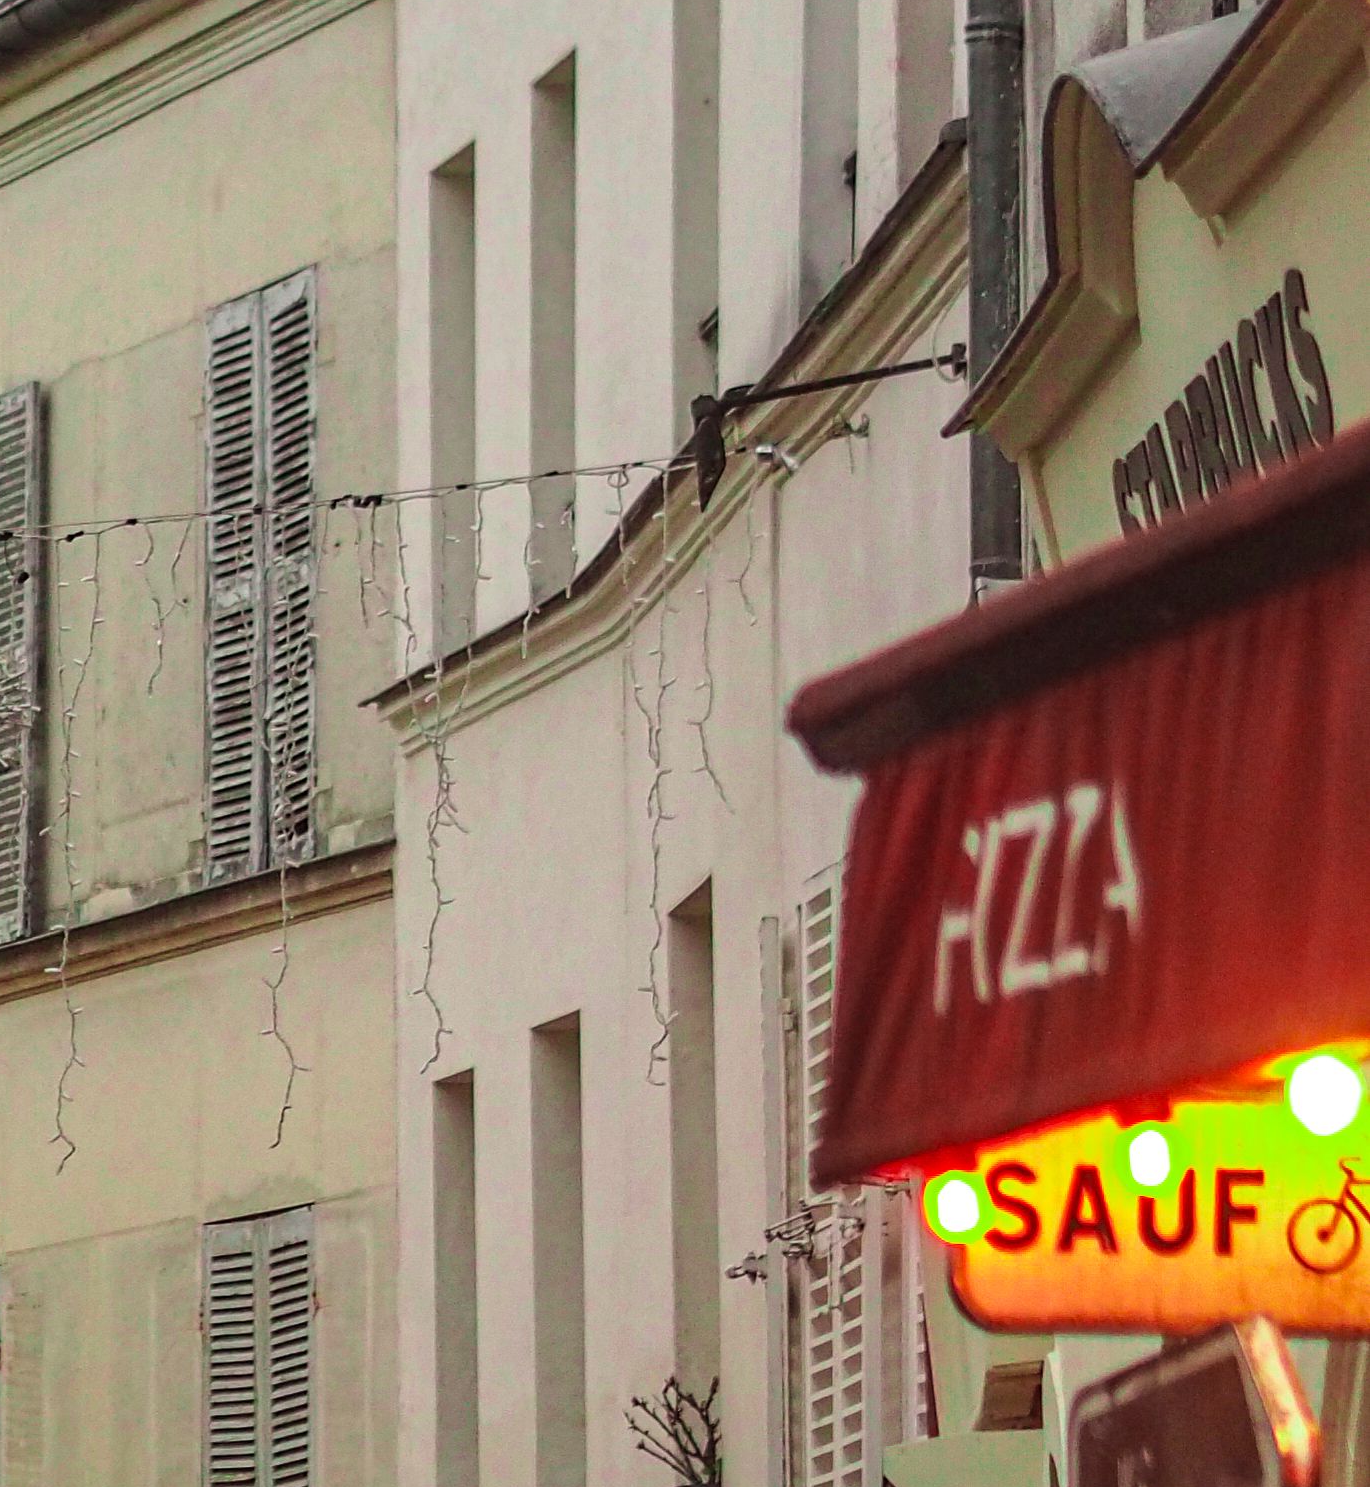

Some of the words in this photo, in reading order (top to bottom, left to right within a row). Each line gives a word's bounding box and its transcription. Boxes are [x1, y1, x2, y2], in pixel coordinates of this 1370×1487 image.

[1113, 268, 1336, 538] STARBUCKS
[933, 776, 1144, 1017] PIZZA
[984, 1160, 1265, 1257] SAUF
